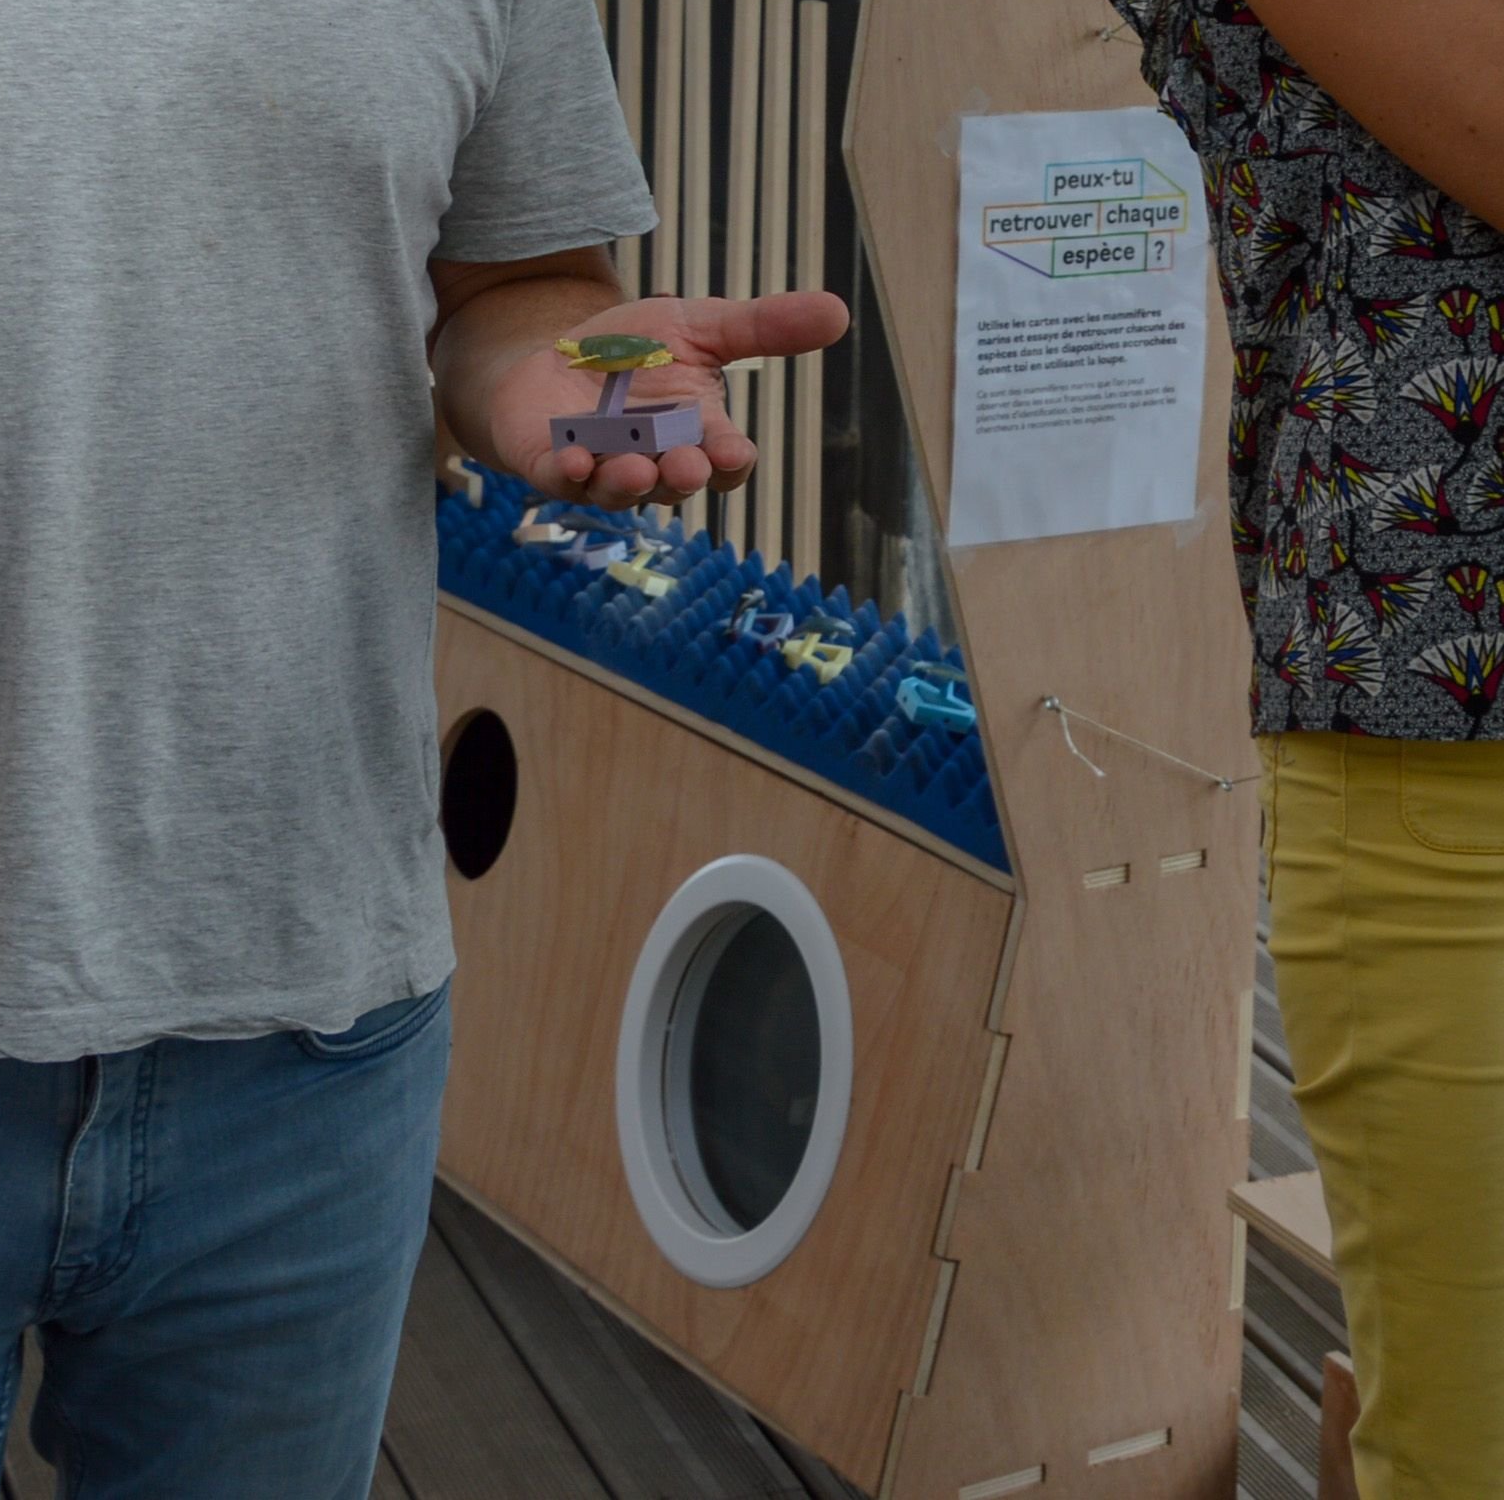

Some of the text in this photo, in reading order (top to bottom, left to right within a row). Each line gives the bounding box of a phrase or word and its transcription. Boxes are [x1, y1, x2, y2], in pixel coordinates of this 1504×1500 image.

[1053, 169, 1134, 196] peux-tu
[990, 204, 1180, 233] retrouver chaque
[1062, 240, 1165, 269] espèce ?
[978, 308, 1161, 331] Utilise les cartes avec les mammifères
[978, 320, 1185, 345] marins et essaye de retrouver chacune des
[978, 336, 1177, 362] espèces dans les diapositives accrochées
[978, 365, 1011, 375] devant
[1014, 361, 1027, 372] toi
[1045, 359, 1085, 369] utilisant
[1087, 356, 1095, 365] la
[1098, 356, 1127, 367] loupe.
[976, 390, 987, 399] Ce
[1008, 388, 1021, 396] des
[1024, 384, 1068, 394] mammifères
[1097, 381, 1111, 389] que
